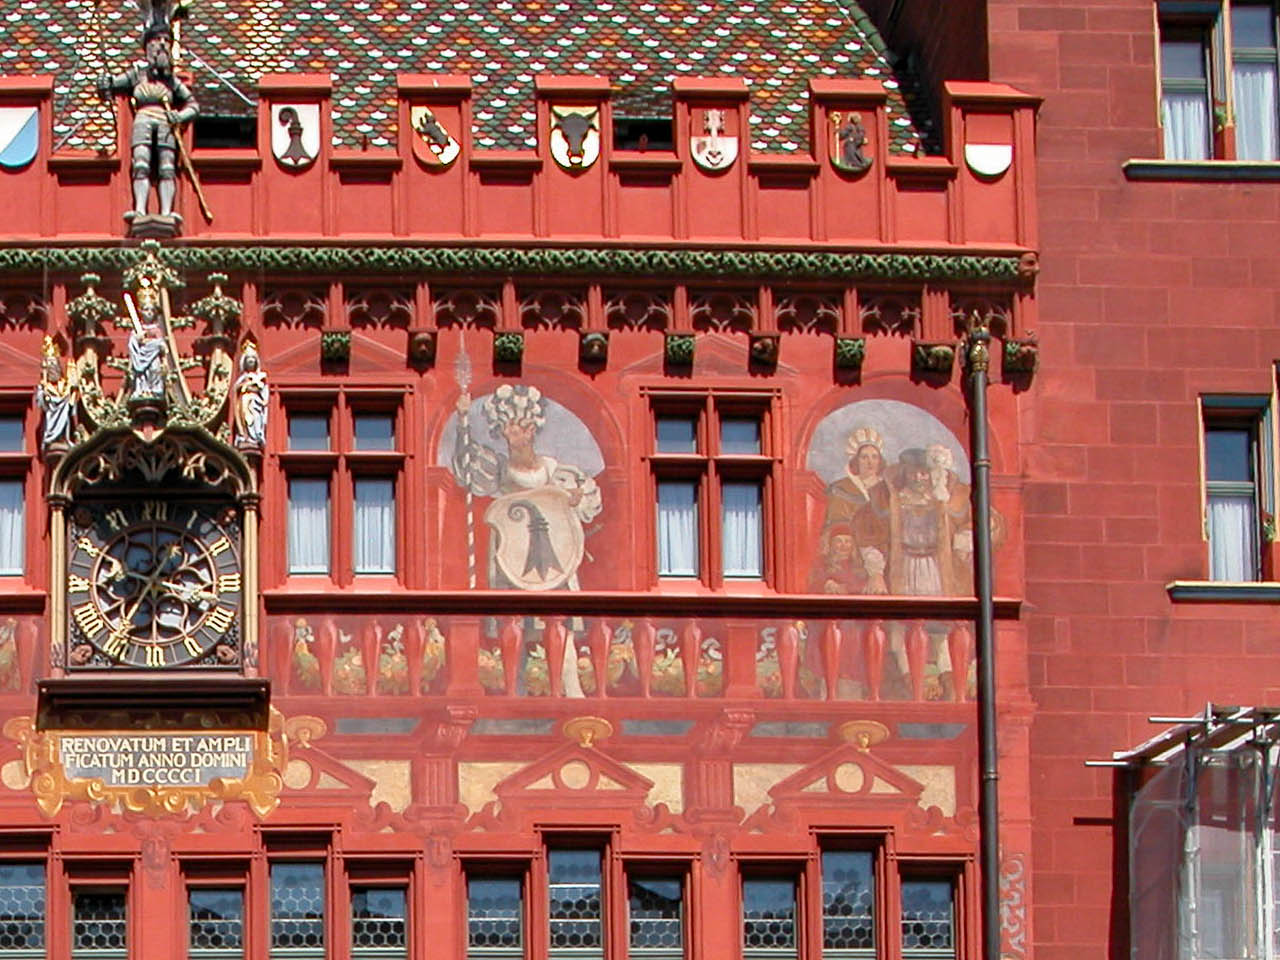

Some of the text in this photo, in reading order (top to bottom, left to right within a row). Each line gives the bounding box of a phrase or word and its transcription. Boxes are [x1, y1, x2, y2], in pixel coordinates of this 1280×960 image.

[62, 736, 250, 755] RENOVATUM ET AMPLI
[65, 753, 247, 768] FICATUM ANNO DOMINI
